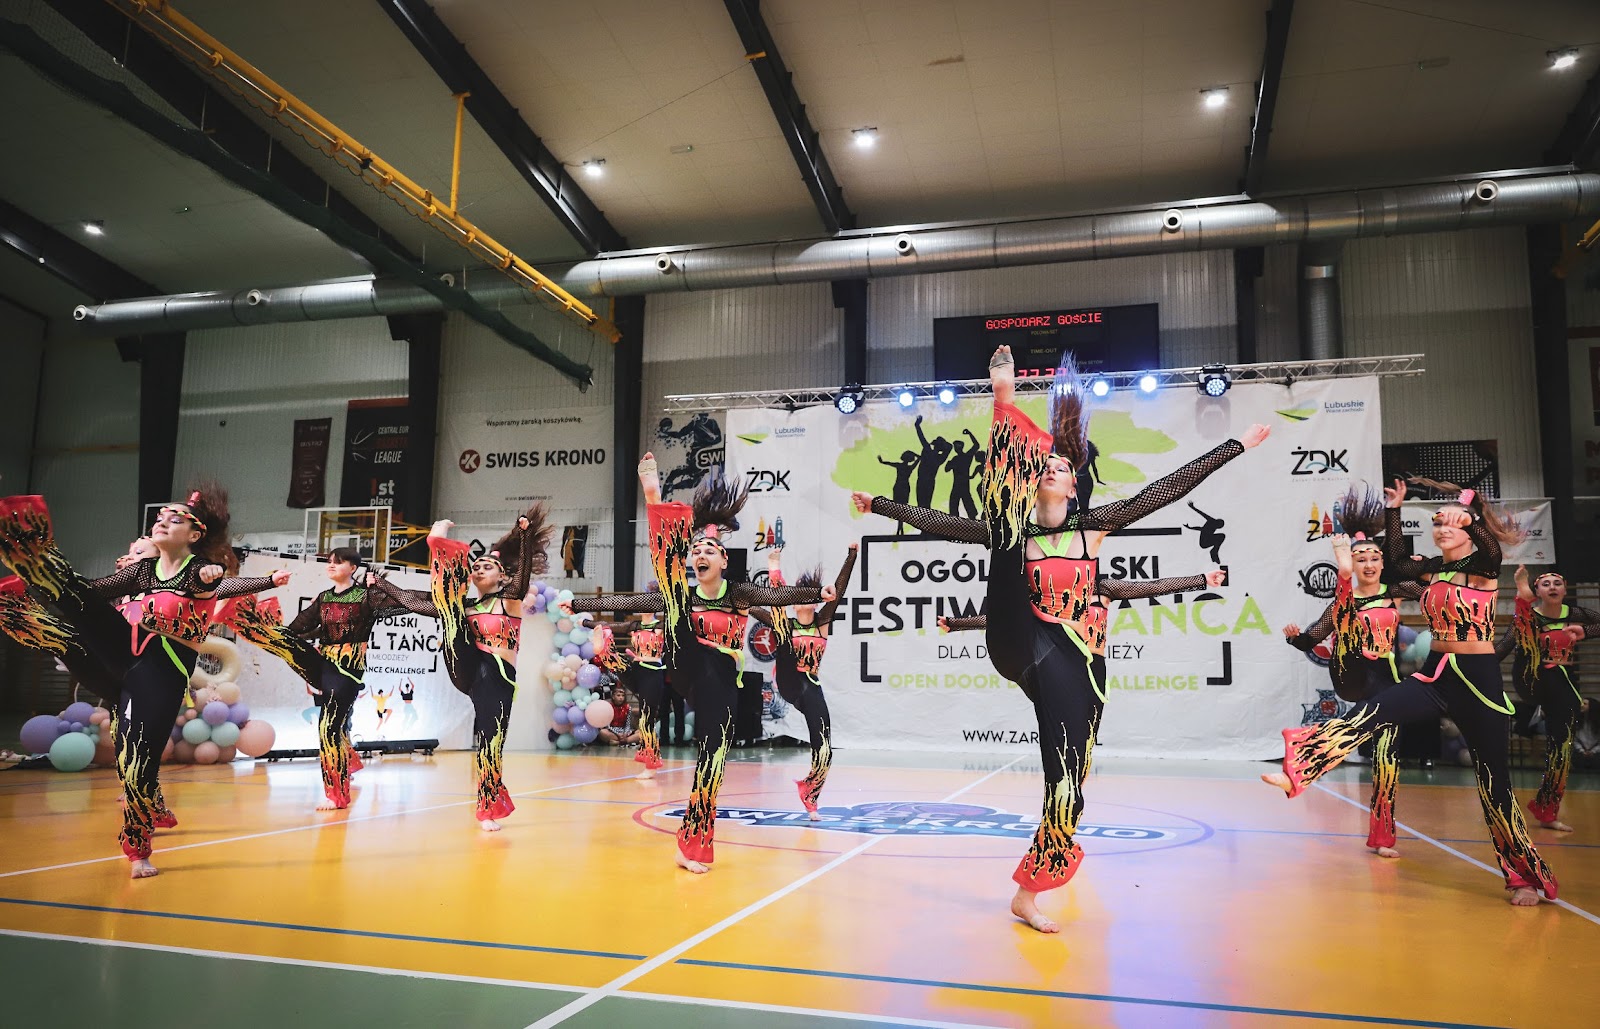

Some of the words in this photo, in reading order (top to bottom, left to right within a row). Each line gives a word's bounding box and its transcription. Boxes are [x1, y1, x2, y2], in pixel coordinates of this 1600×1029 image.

[985, 315, 1051, 330] GOSPODARZ
[1324, 400, 1364, 409] Lubuskie
[377, 426, 399, 435] CENTRAL
[486, 419, 520, 428] Wspieramy
[774, 426, 806, 435] Lubuskie
[374, 450, 403, 464] LEAGUE
[485, 451, 540, 469] SWISS
[545, 448, 606, 467] KRONO
[700, 450, 726, 465] SWI
[1290, 445, 1349, 476] ŻDK
[746, 466, 791, 493] ŻDK
[370, 478, 395, 496] 1st
[370, 496, 394, 507] place
[938, 645, 971, 659] DLA
[384, 666, 426, 675] CHALLENGE
[887, 673, 939, 689] OPEN
[944, 673, 1000, 689] DOOR
[1108, 674, 1200, 691] ALLENGE
